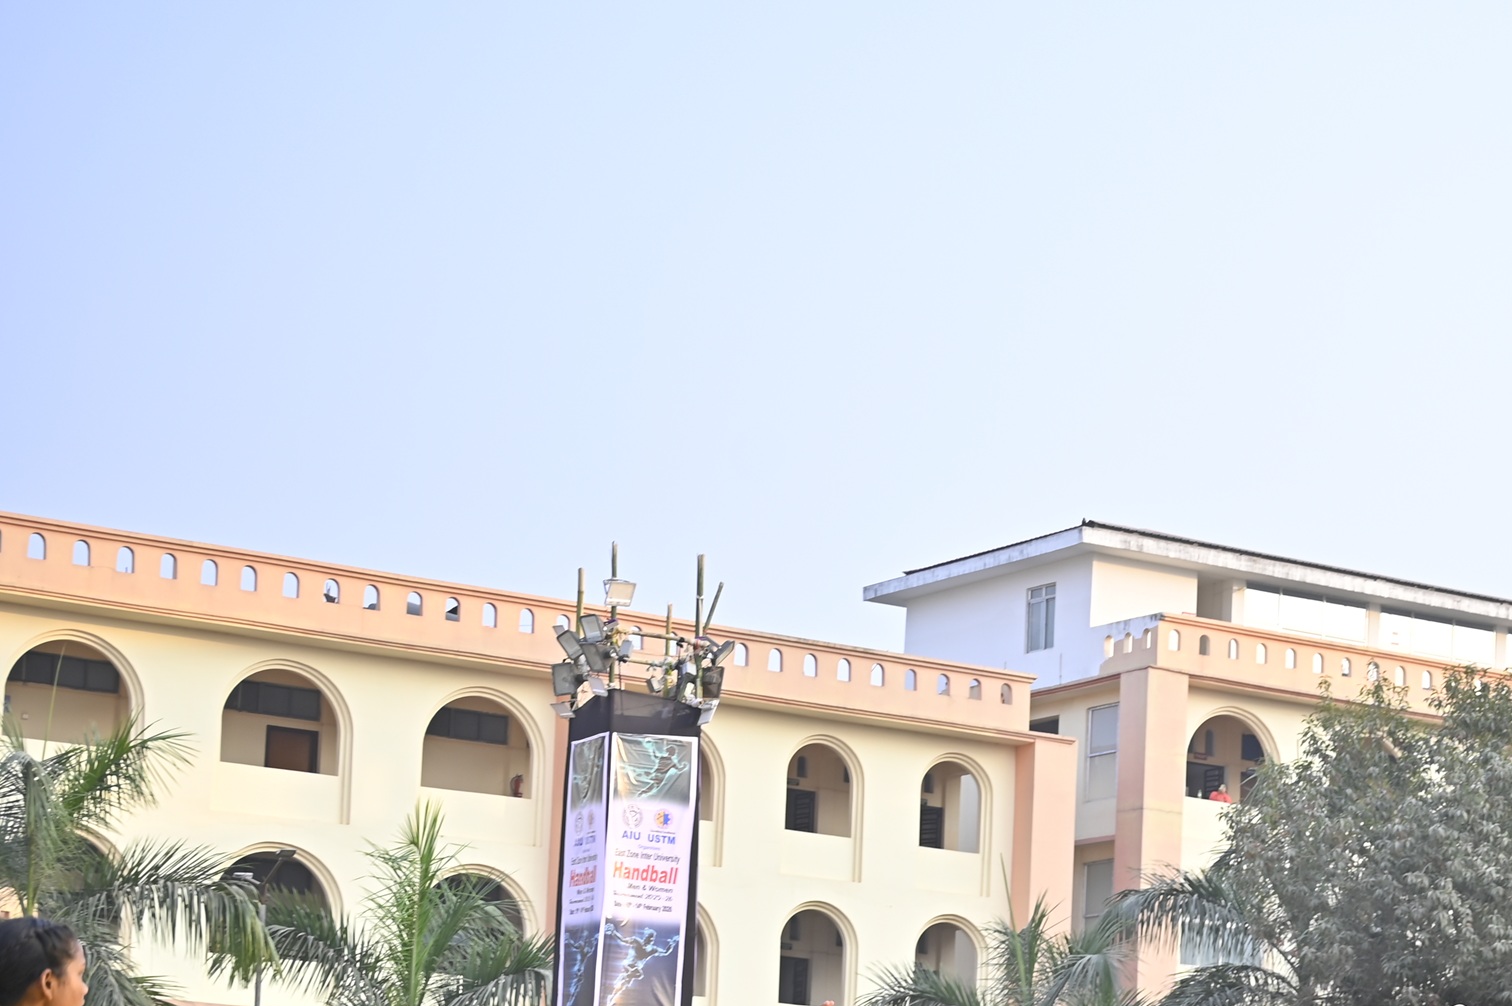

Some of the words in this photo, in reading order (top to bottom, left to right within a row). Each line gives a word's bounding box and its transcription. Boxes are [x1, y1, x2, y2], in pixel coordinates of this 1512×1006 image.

[622, 830, 641, 840] AIU
[648, 833, 676, 845] USTM
[613, 861, 678, 884] Handball
